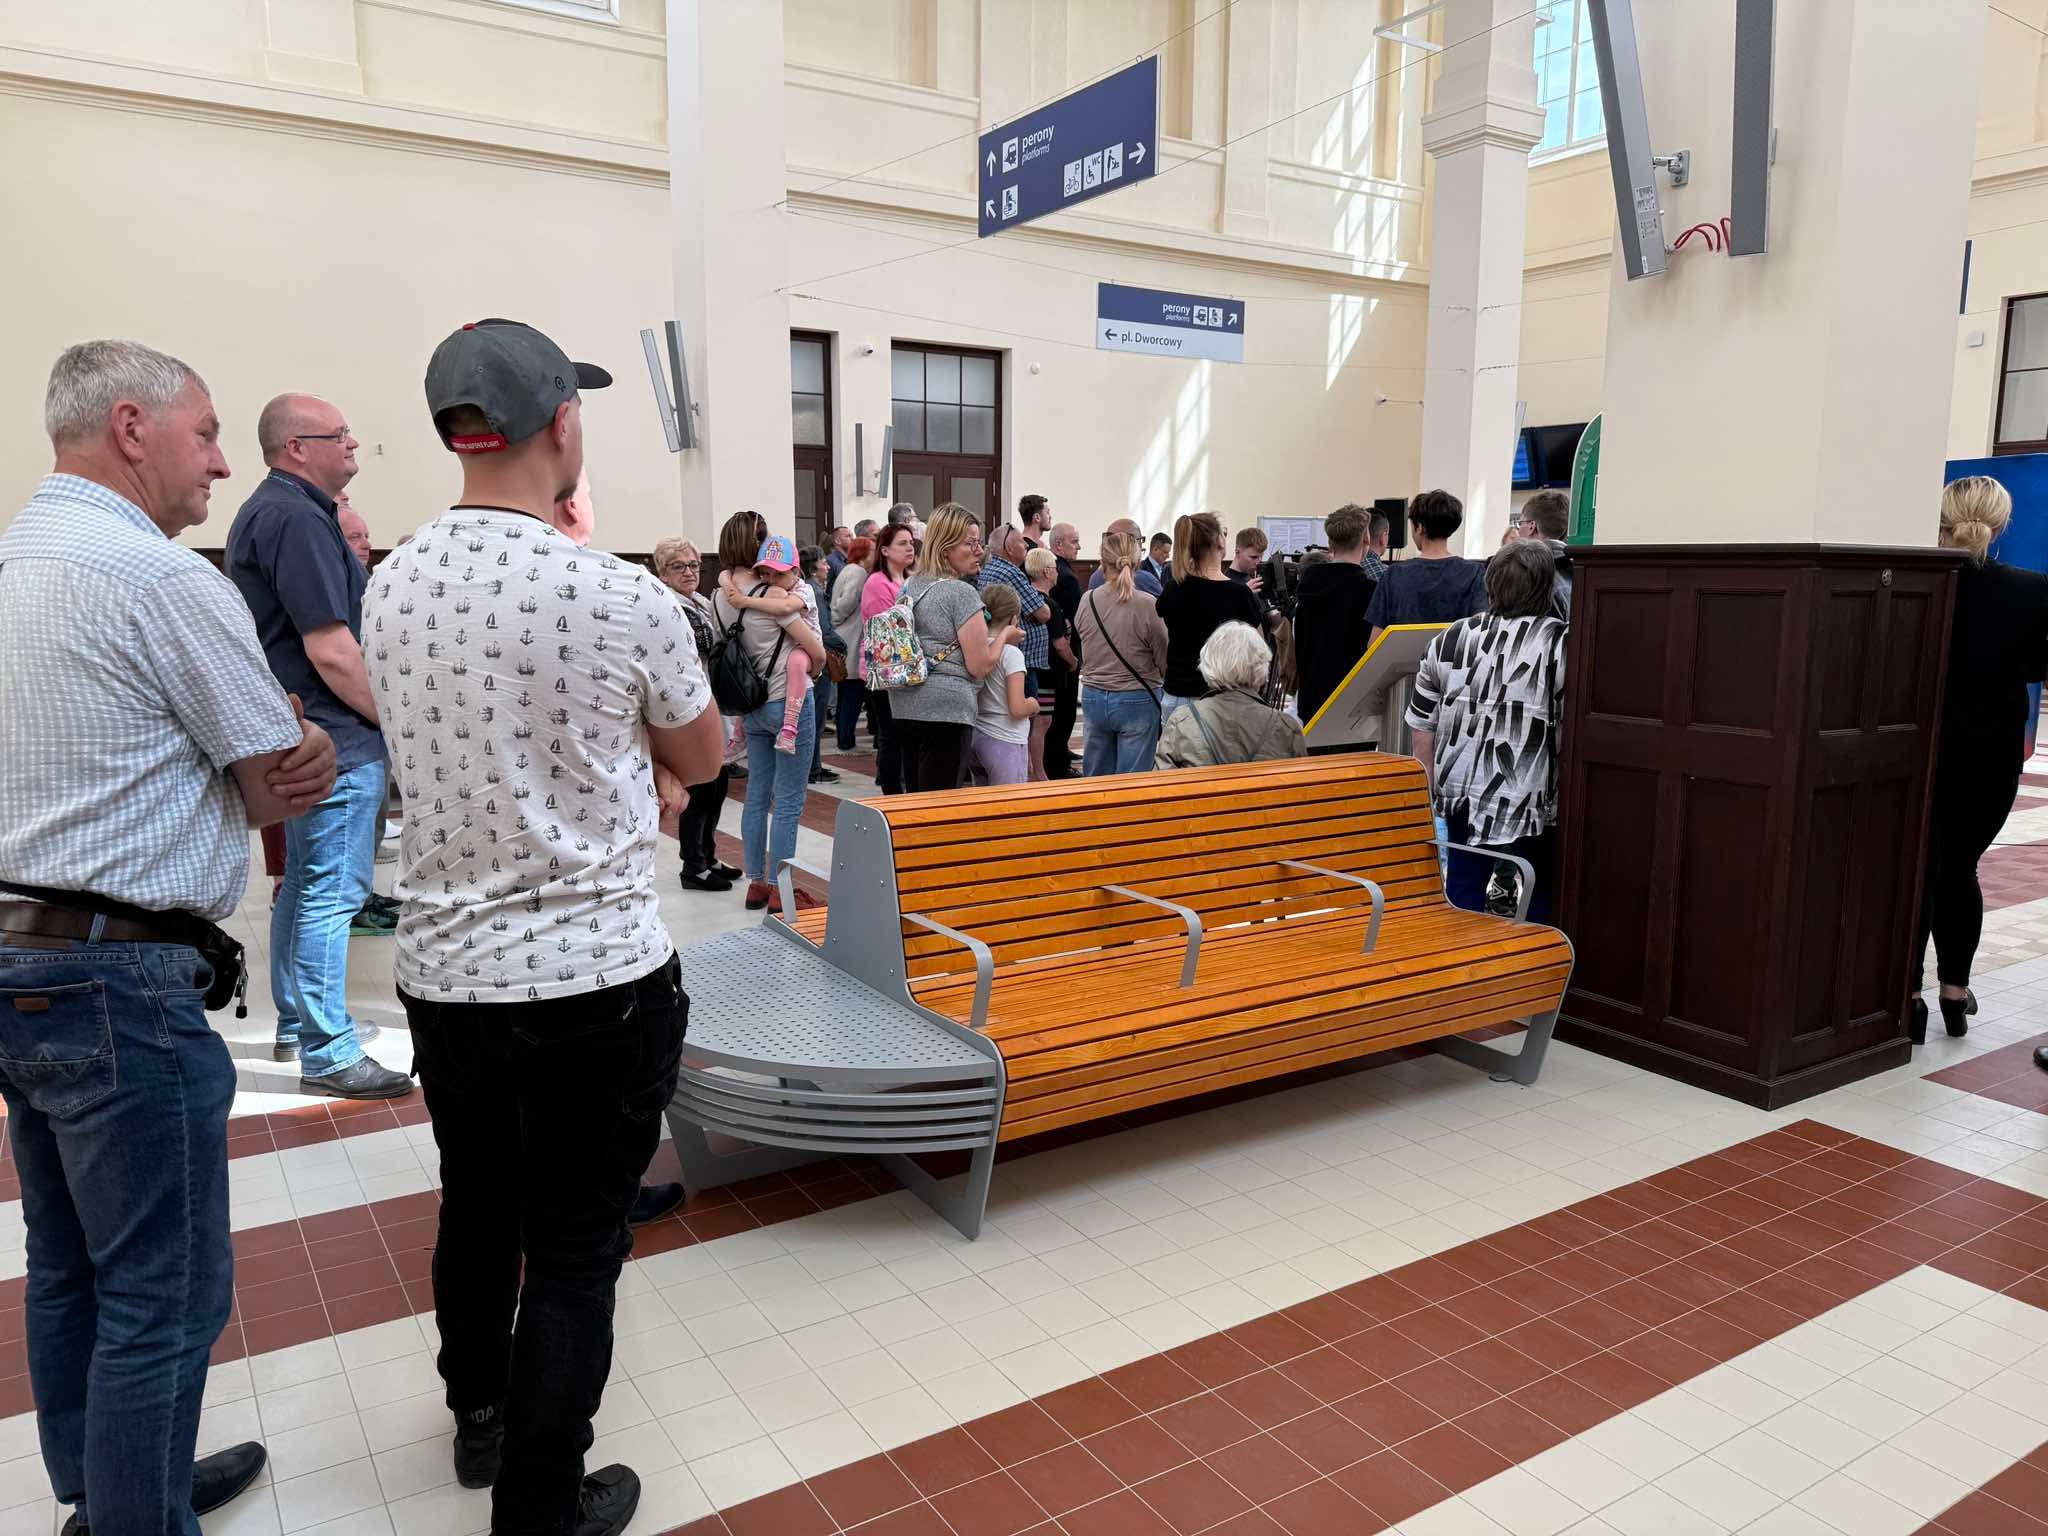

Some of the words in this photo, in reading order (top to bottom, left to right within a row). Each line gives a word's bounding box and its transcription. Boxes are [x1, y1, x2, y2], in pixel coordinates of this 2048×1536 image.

[1022, 125, 1054, 152] perony
[1021, 143, 1050, 166] platforms
[1092, 155, 1101, 167] WC
[1163, 303, 1190, 315] perony
[1121, 331, 1133, 344] pl.
[1135, 332, 1182, 349] Dworcowy
